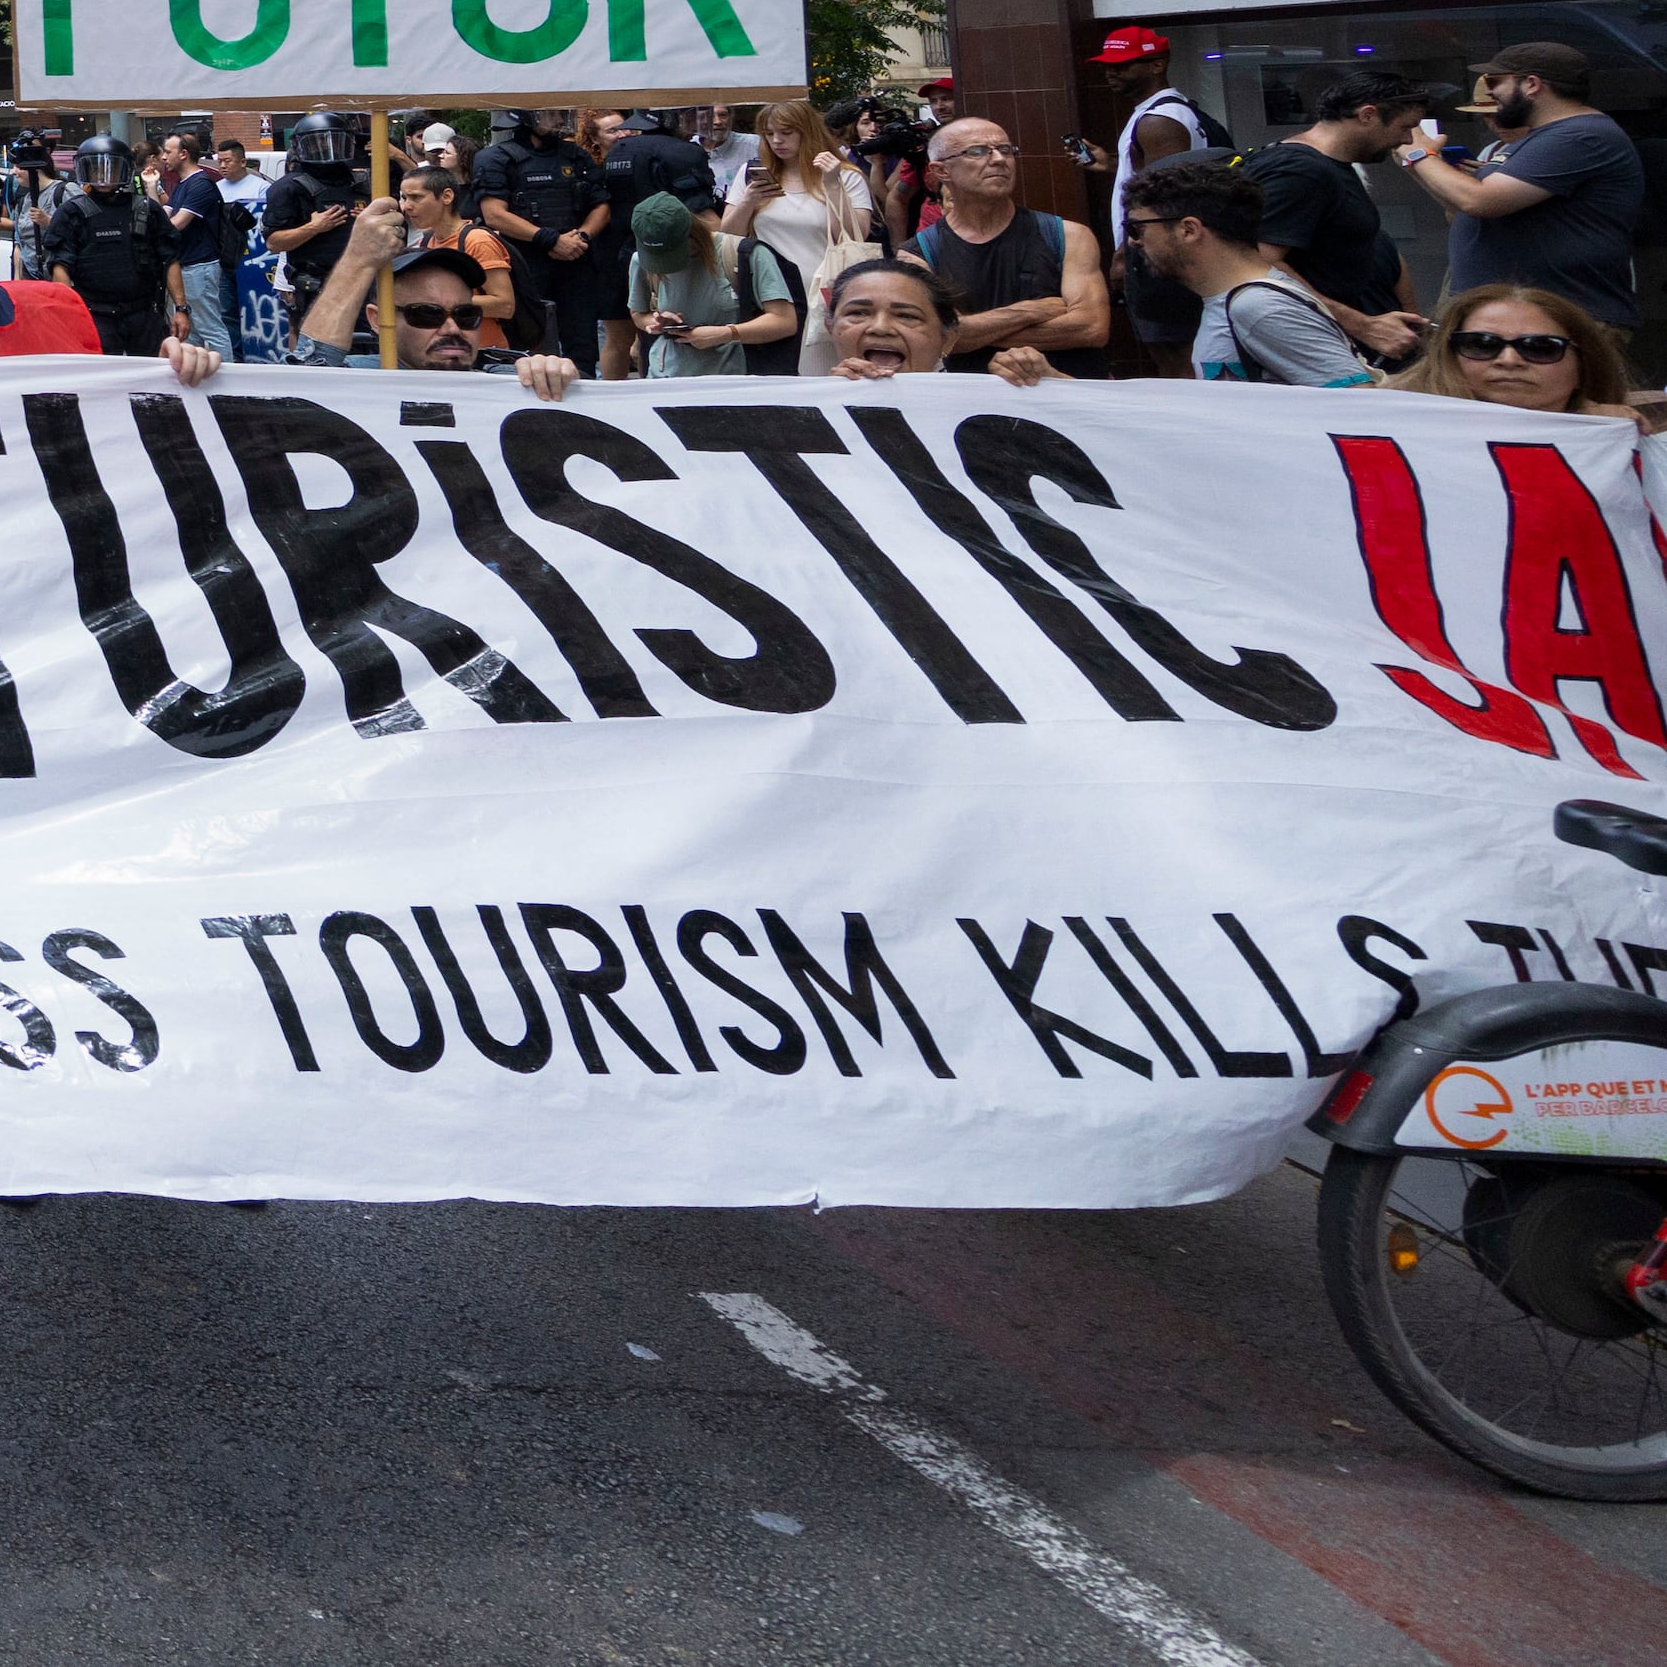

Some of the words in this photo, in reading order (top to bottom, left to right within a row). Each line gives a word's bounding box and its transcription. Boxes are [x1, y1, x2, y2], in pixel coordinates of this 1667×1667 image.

[201, 902, 957, 1079] TOURISM
[955, 912, 1429, 1080] KILLS
[1525, 1083, 1582, 1099] L'APP
[1587, 1081, 1628, 1099] QUE
[1632, 1079, 1656, 1095] ET
[1534, 1101, 1578, 1118] PER
